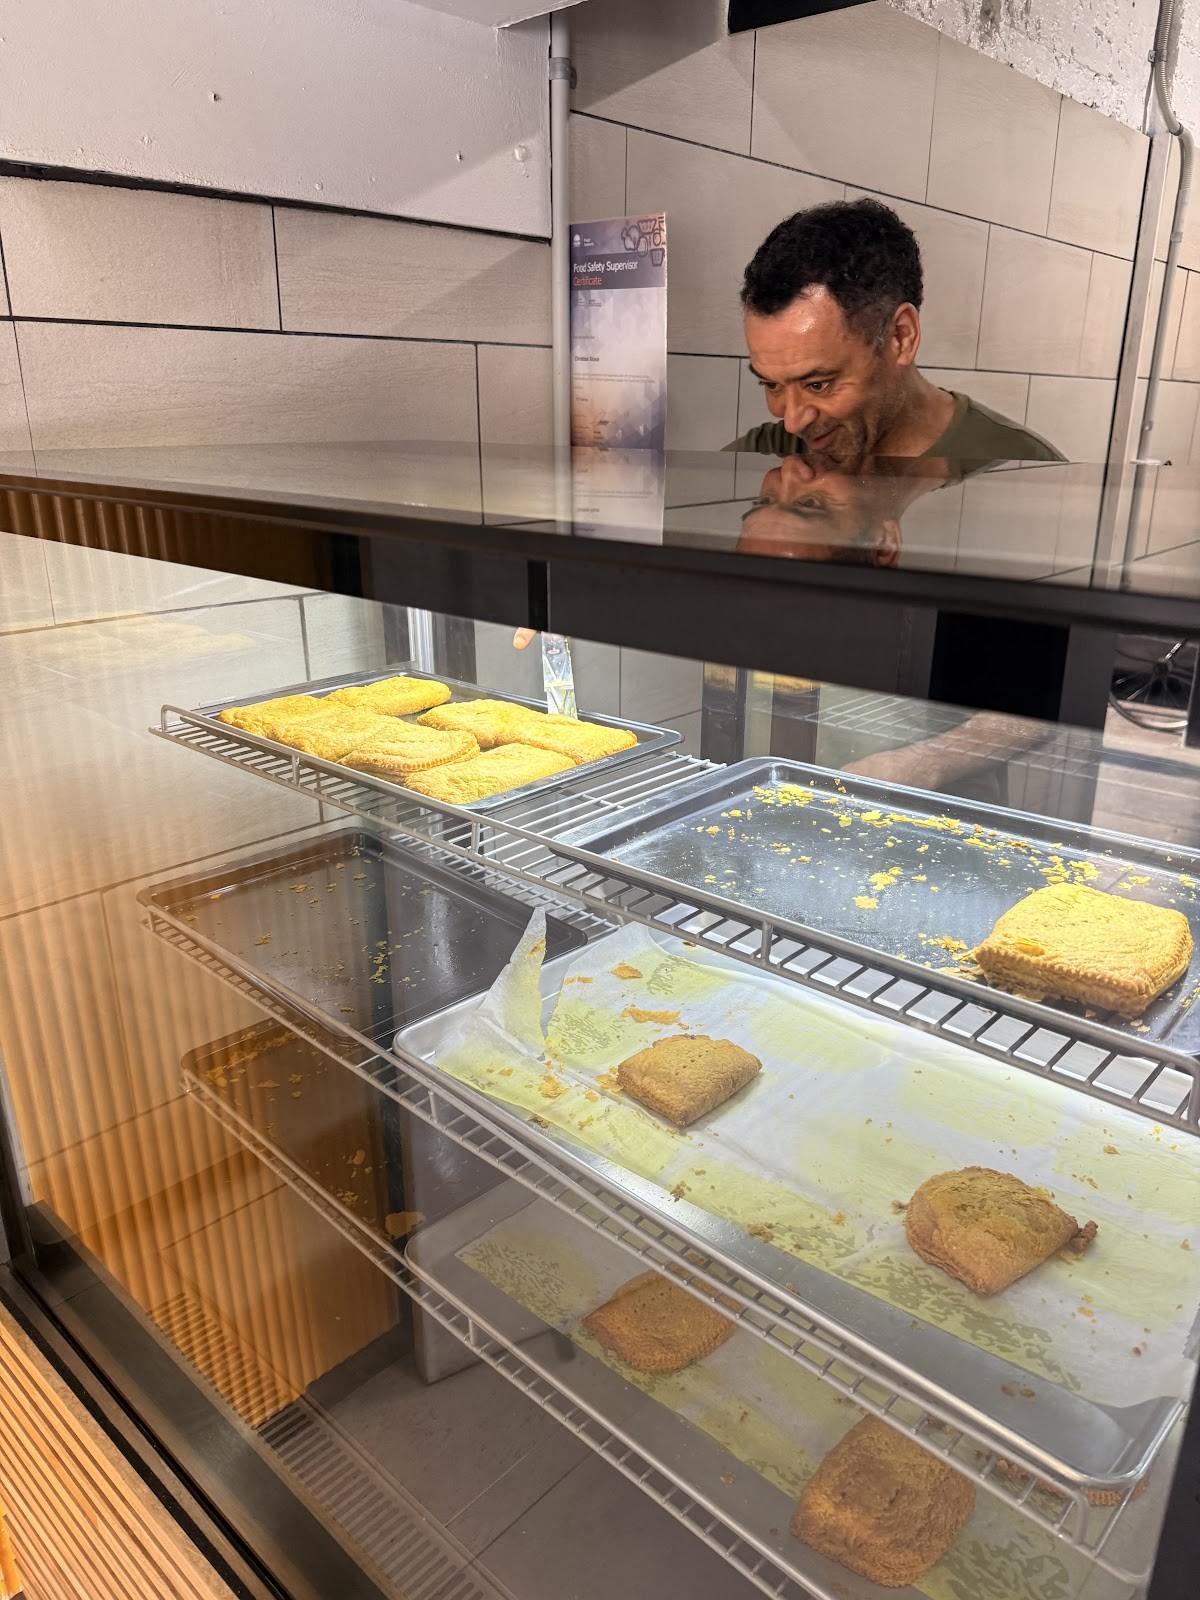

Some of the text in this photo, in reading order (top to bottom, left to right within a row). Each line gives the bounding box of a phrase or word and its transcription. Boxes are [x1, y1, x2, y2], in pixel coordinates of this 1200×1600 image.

[573, 260, 638, 273] Food Safety Supervisor
[573, 276, 602, 286] Certificate
